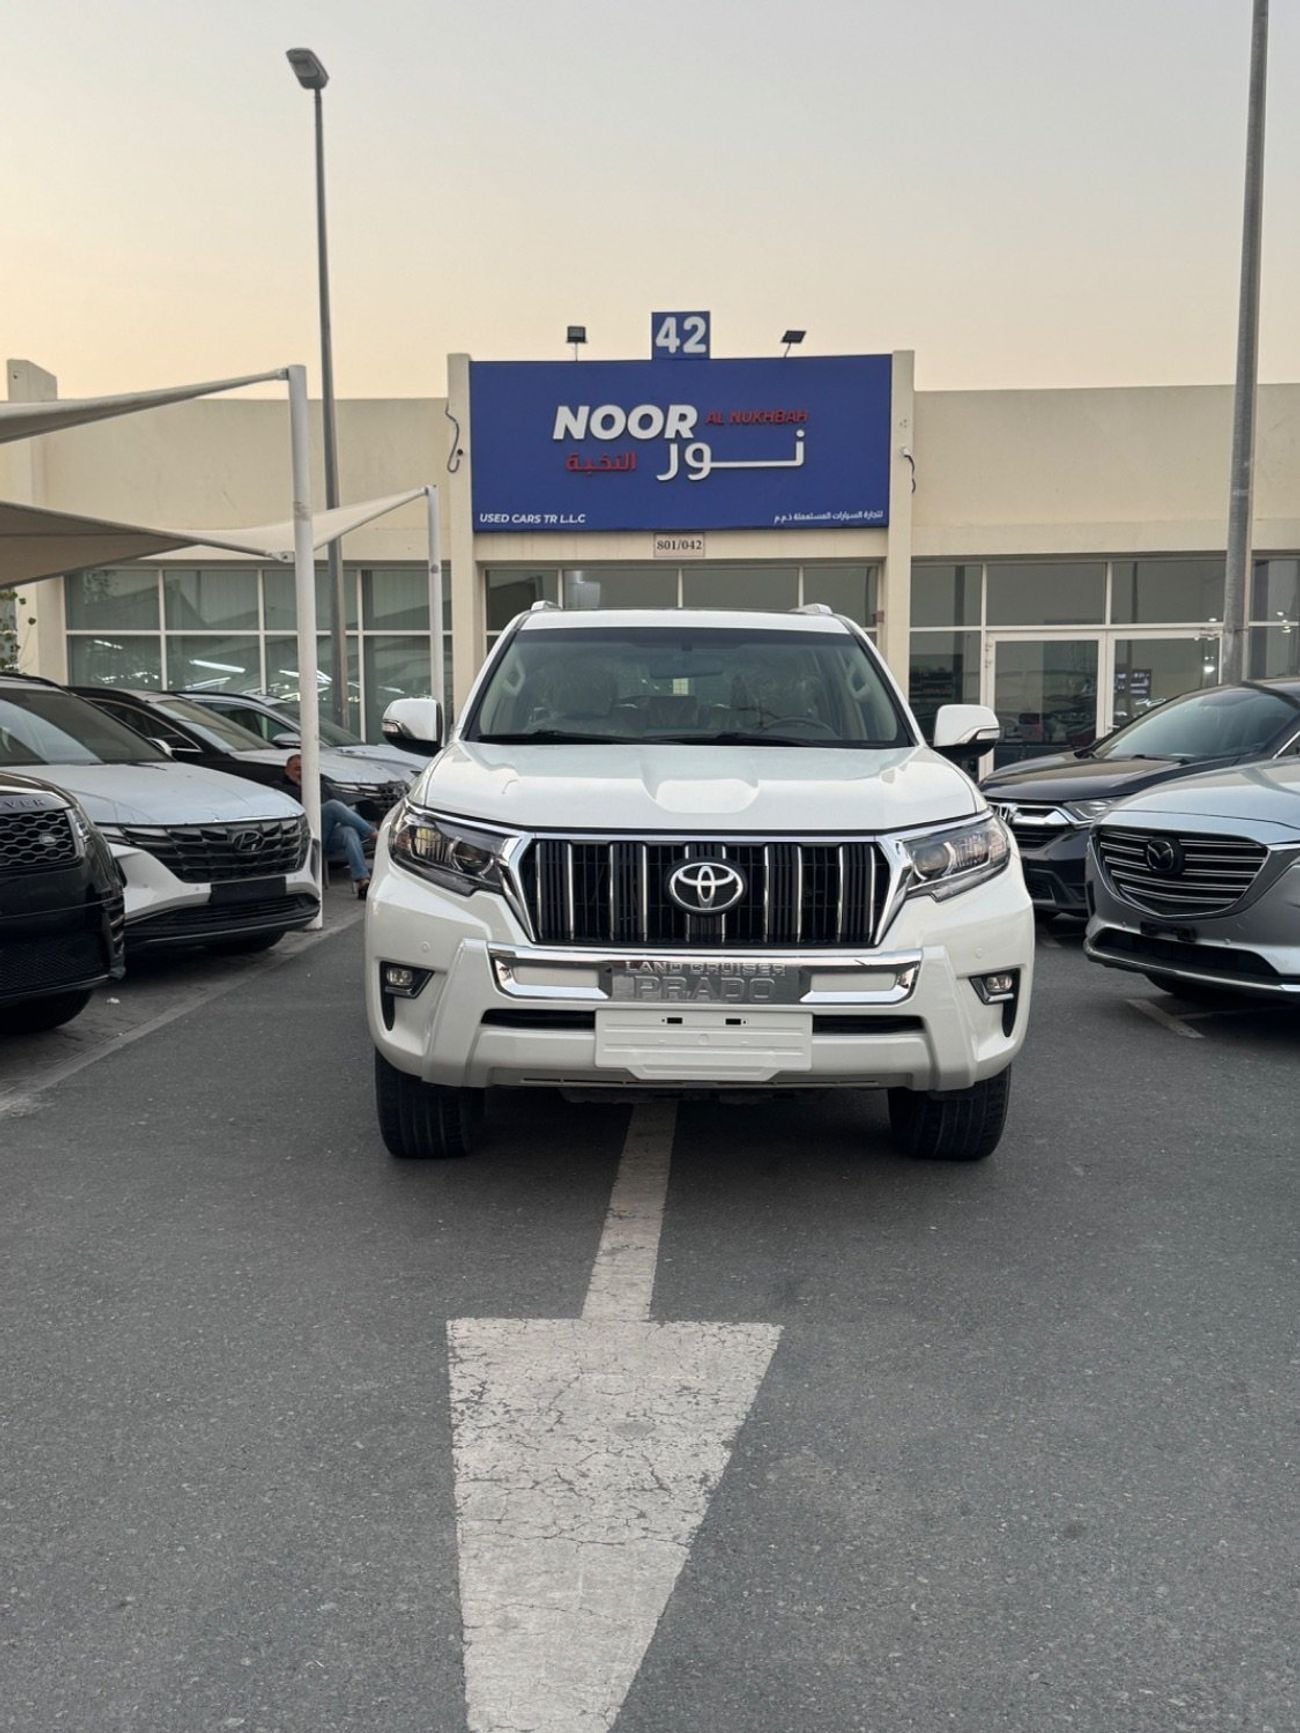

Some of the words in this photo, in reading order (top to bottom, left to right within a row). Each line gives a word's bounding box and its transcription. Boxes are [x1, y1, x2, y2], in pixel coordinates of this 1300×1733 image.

[655, 316, 706, 353] 42
[553, 404, 698, 440] NOOR
[705, 411, 724, 425] AL
[729, 409, 808, 424] NUKHBAH
[566, 452, 636, 474] النخبة
[656, 429, 805, 481] نور
[480, 513, 510, 523] USED
[511, 514, 541, 524] CARS
[543, 514, 558, 524] TR
[560, 514, 586, 524] L.L.C
[832, 511, 862, 521] السيارات
[656, 540, 703, 551] 801/042
[625, 961, 683, 974] LAND
[690, 963, 786, 977] CRUISER
[634, 975, 776, 1000] PRADO
